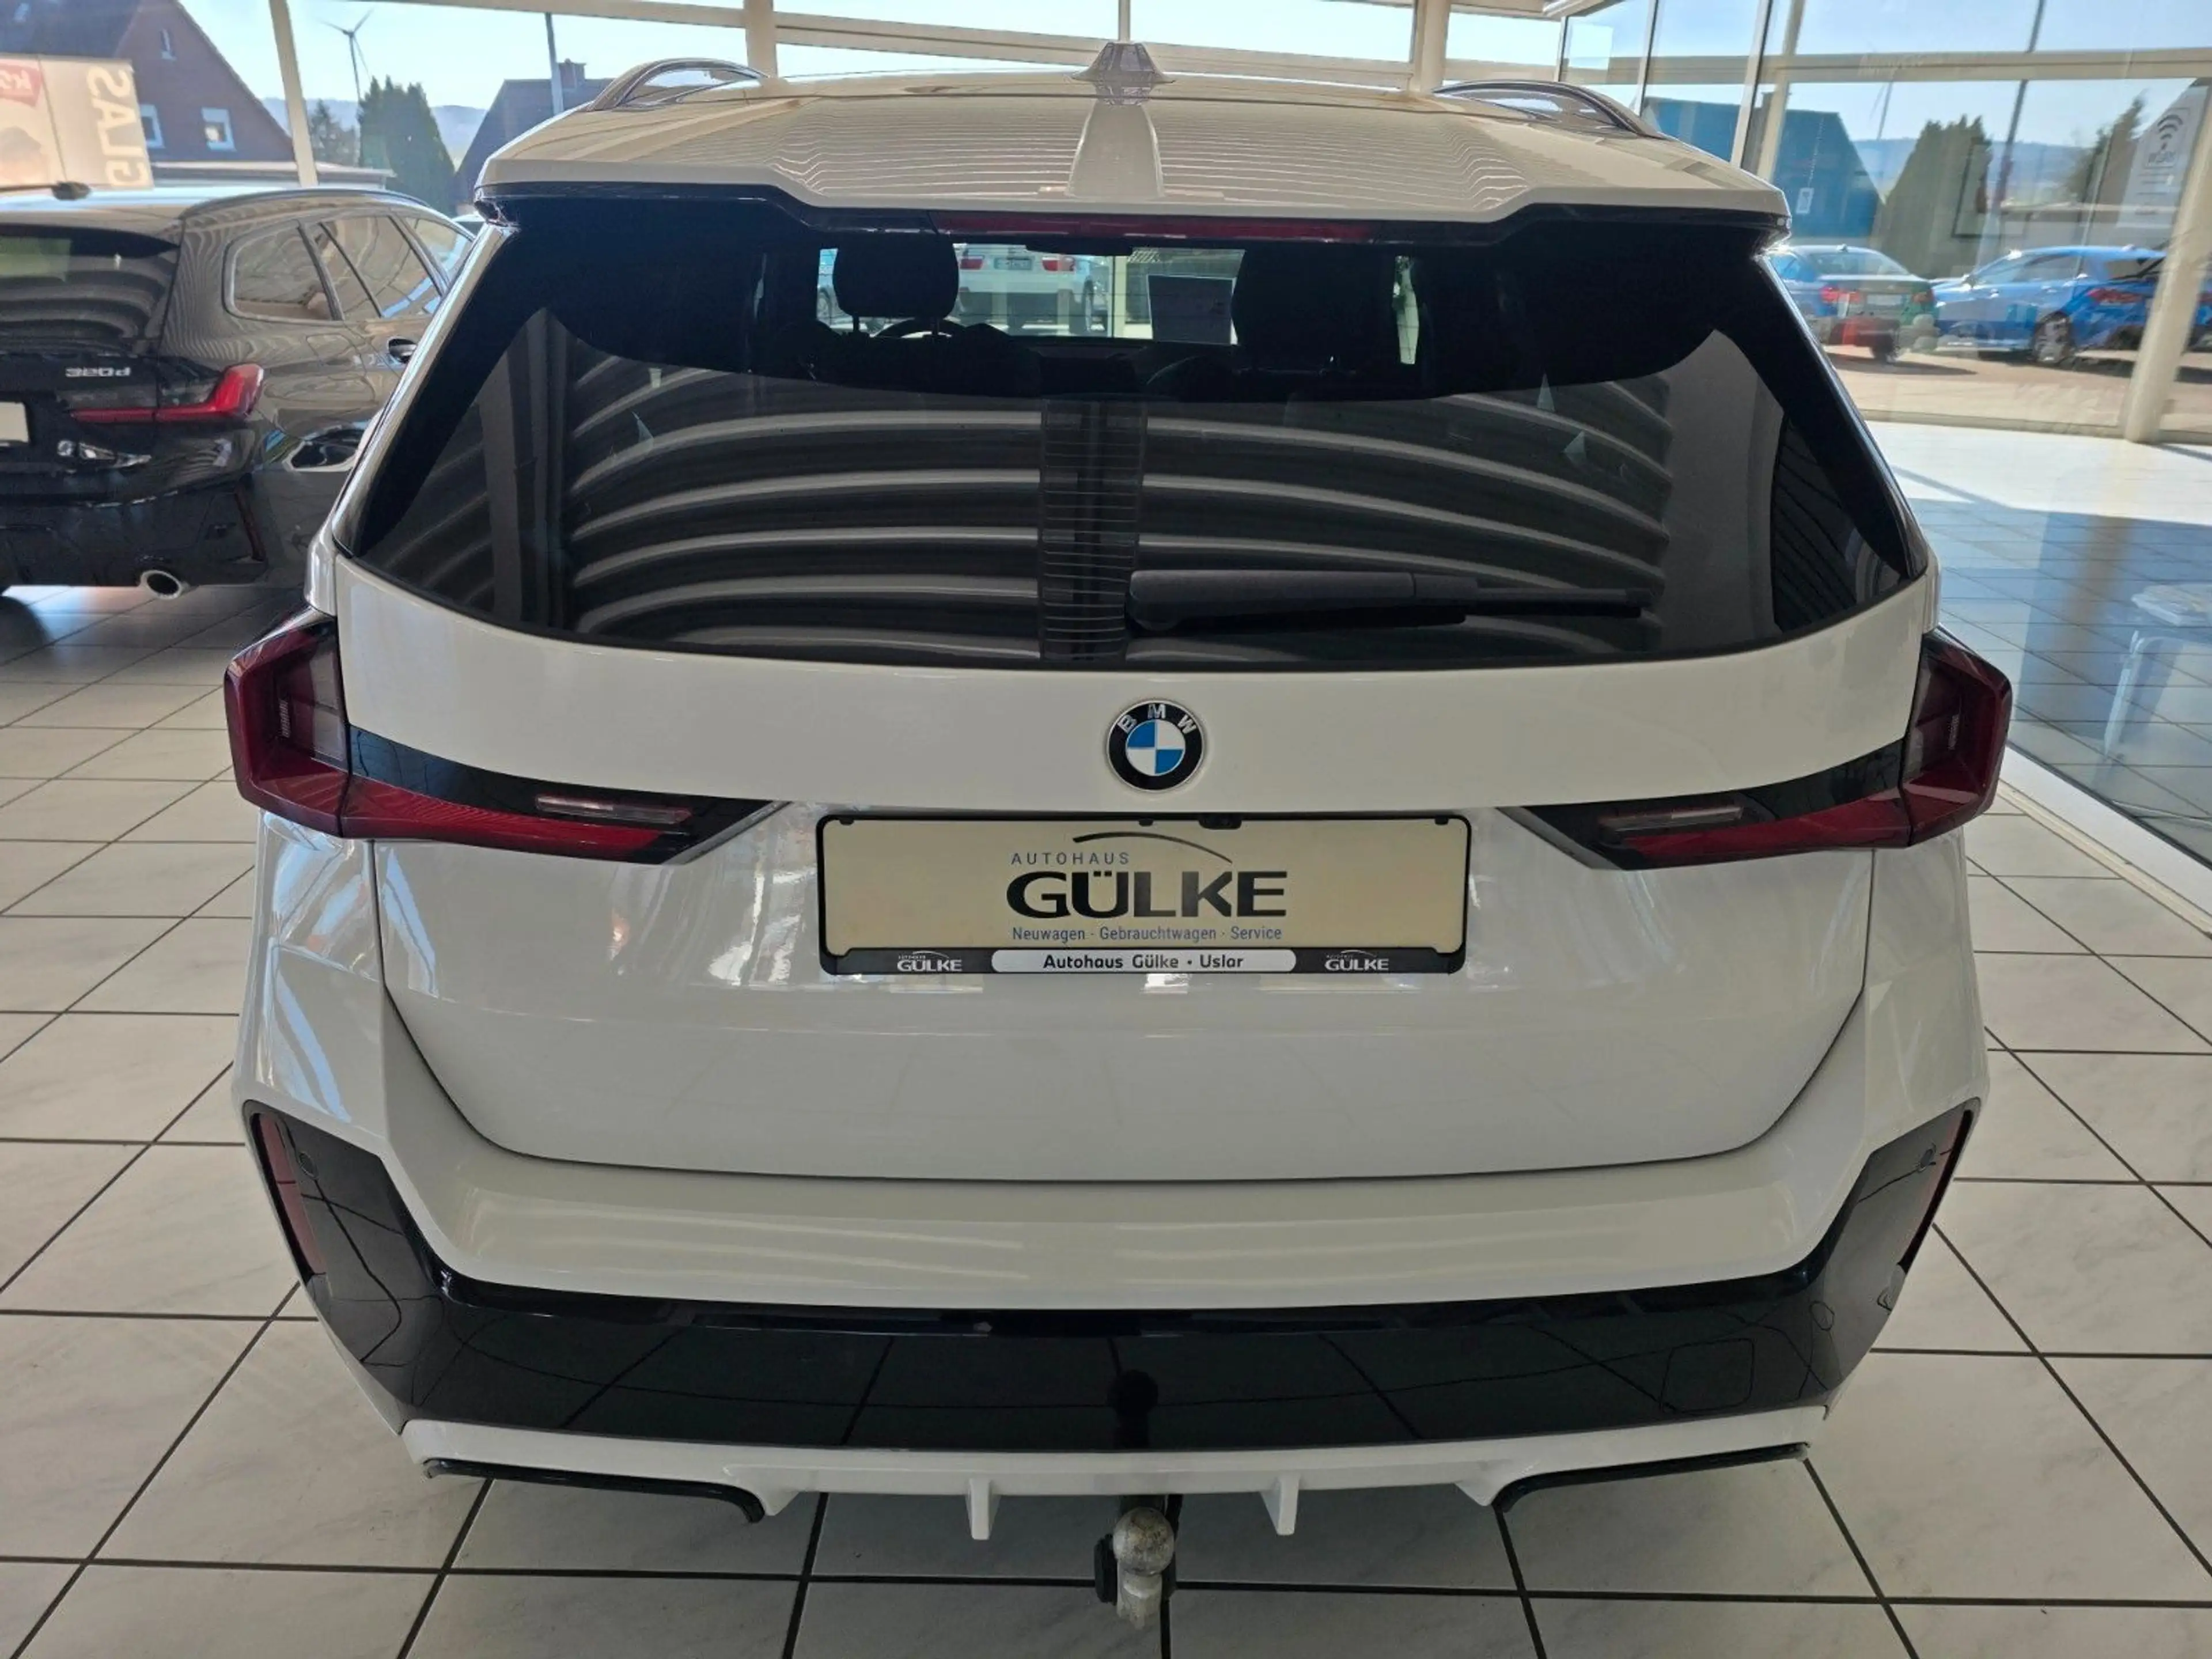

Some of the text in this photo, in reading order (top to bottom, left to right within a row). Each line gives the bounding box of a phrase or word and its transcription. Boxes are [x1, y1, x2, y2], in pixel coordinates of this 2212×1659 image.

[66, 367, 131, 377] 320d
[1117, 703, 1196, 734] BMW
[1011, 853, 1130, 865] AUTOHAUS
[1006, 871, 1287, 918] GÜLKE
[1013, 926, 1282, 944] Neuwagen Gebrauchtwagen Service
[1043, 954, 1244, 968] Autohaus Gülke Uslar
